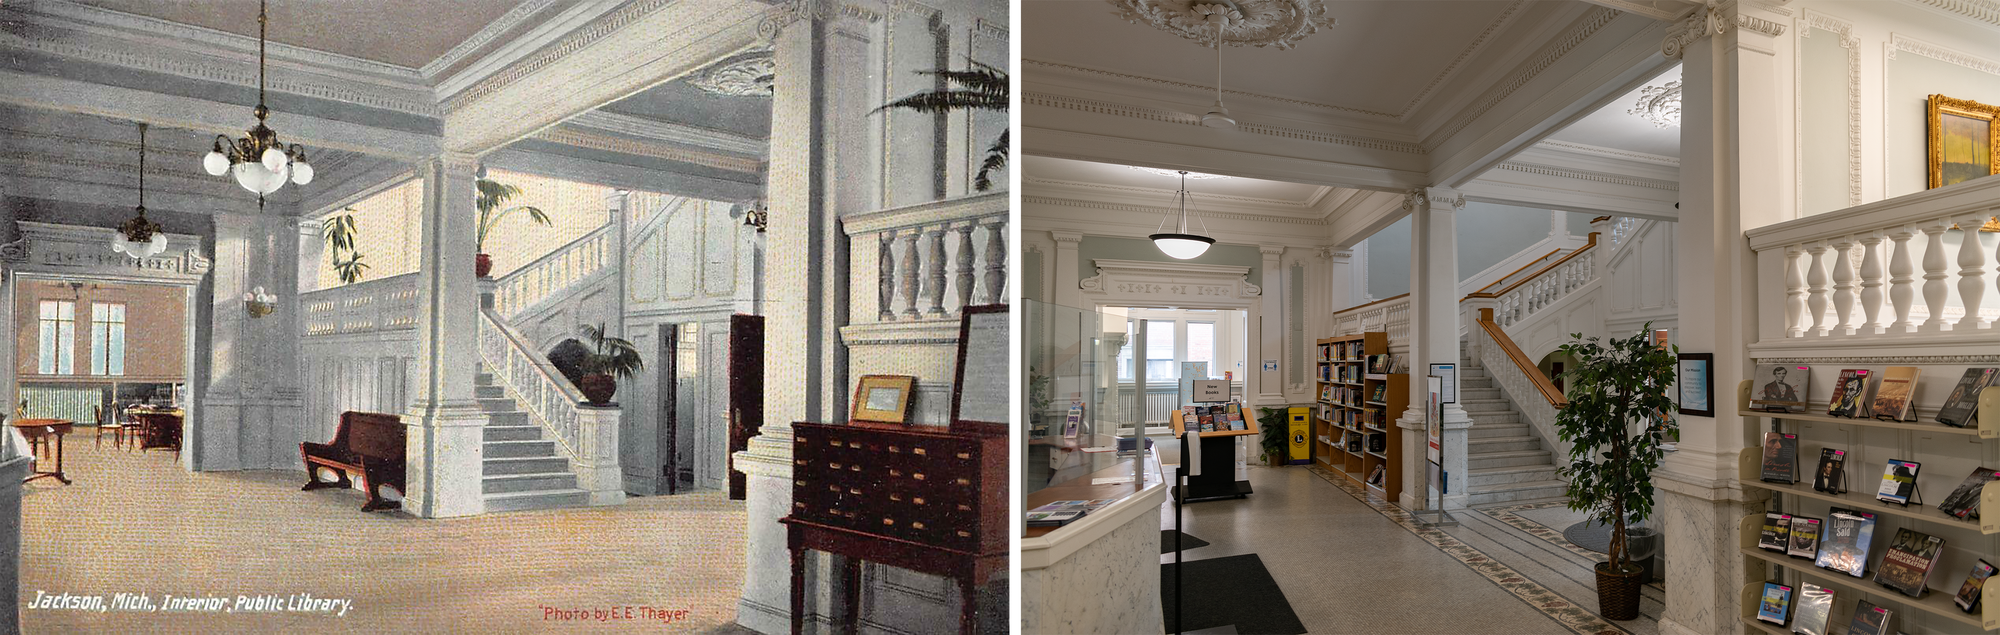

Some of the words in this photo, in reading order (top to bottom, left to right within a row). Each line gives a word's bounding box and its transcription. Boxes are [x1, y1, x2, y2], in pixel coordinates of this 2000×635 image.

[1296, 434, 1303, 443] L
[1833, 518, 1855, 529] Lincoln
[1836, 527, 1851, 537] Said
[1886, 553, 1928, 570] PROCLAMATION
[1888, 548, 1930, 566] EMANCIPATION
